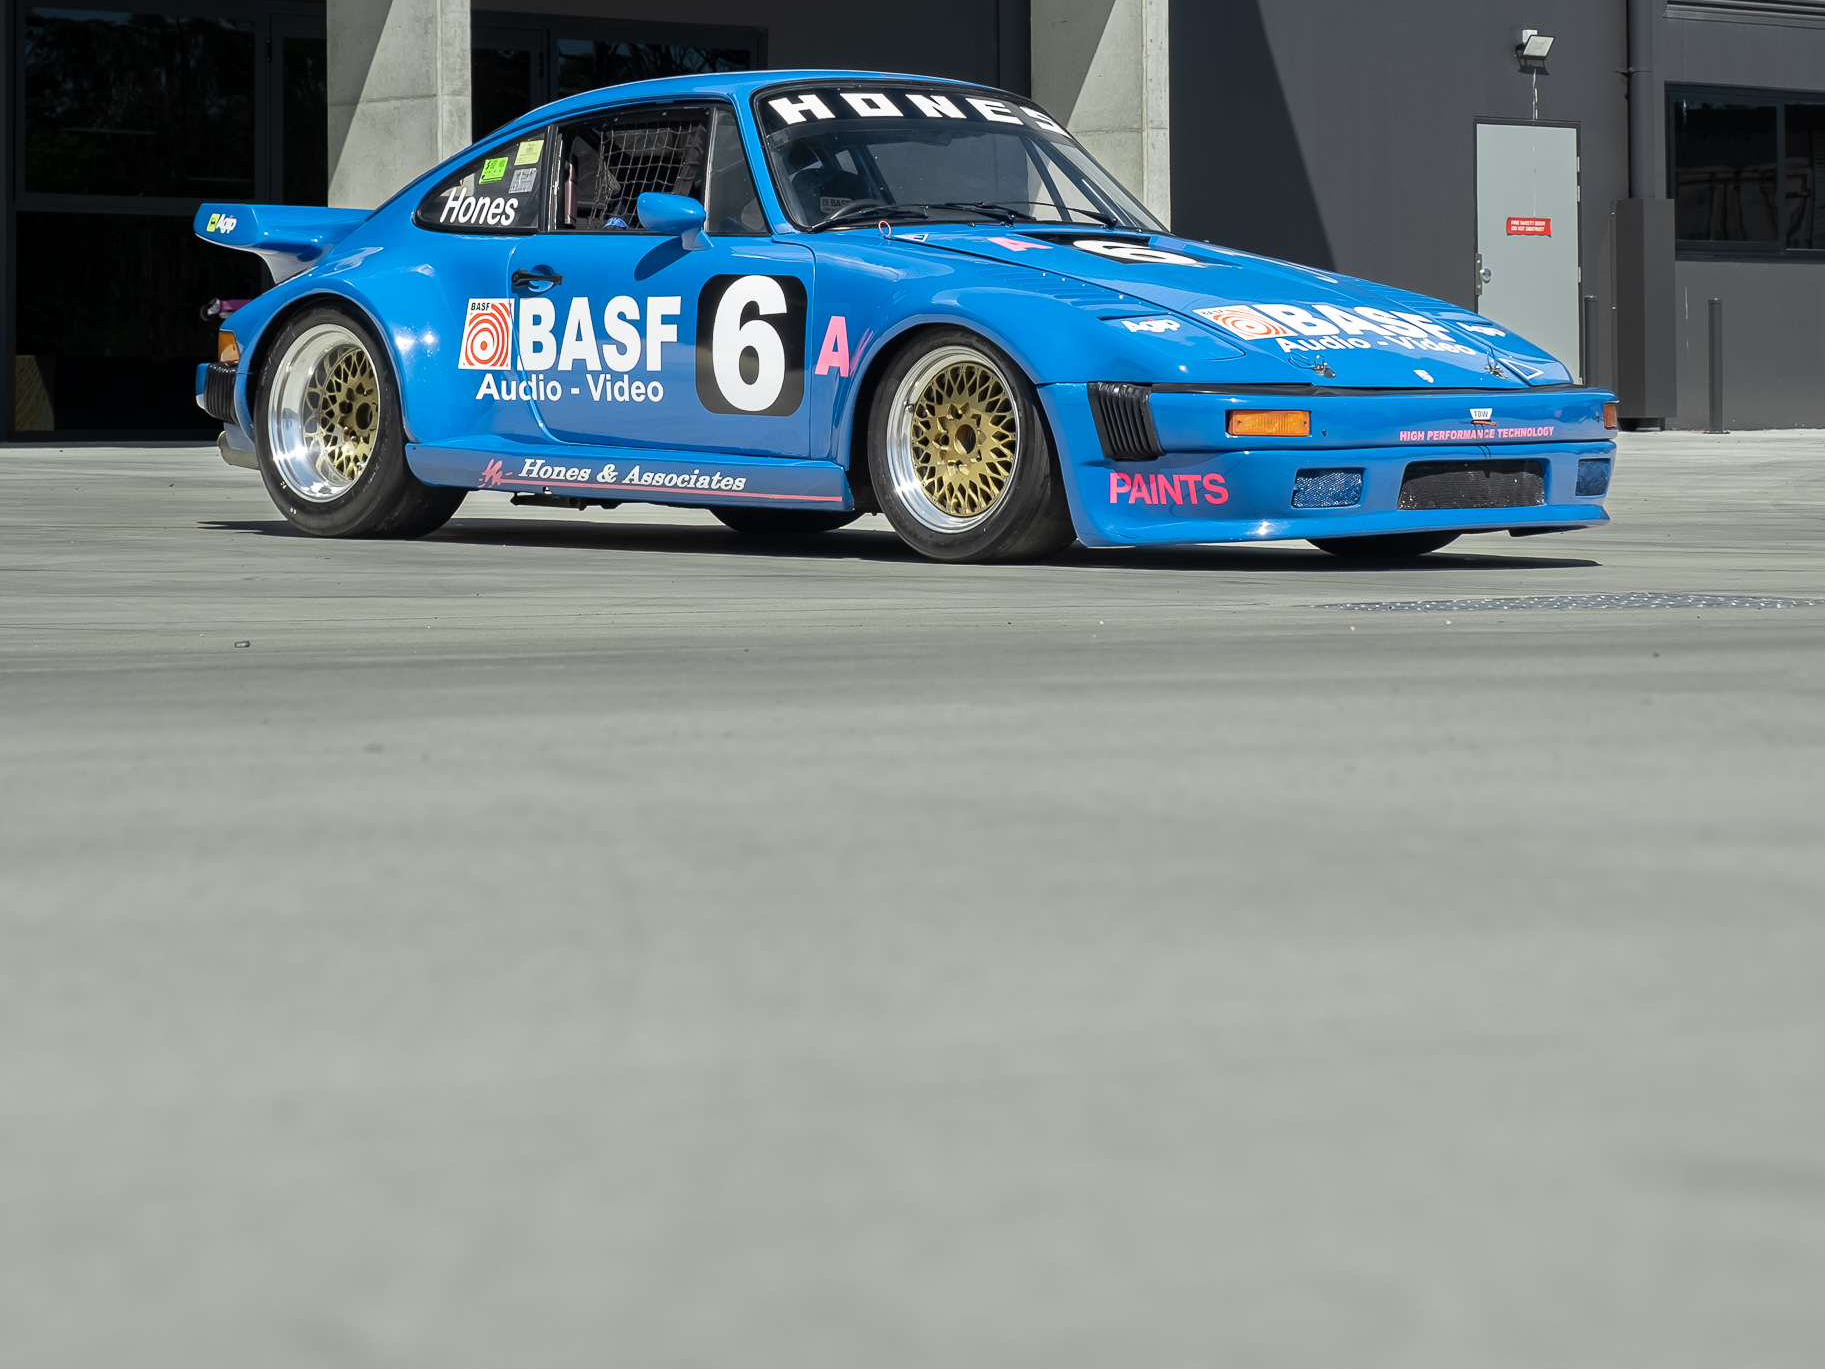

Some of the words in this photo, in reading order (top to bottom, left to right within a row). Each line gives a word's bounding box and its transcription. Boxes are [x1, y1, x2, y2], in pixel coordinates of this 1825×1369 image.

[768, 93, 1074, 139] HONES
[439, 186, 520, 226] Hones
[470, 302, 492, 312] BASF
[1251, 303, 1457, 343] BASF
[517, 295, 682, 372] BASF
[1121, 317, 1181, 333] Agip
[712, 275, 788, 412] 6
[1274, 337, 1370, 353] Audio
[1388, 336, 1477, 356] Video
[475, 373, 562, 401] Audio
[570, 387, 580, 395] -
[585, 373, 664, 402] Video
[1473, 410, 1489, 418] TOW
[1400, 431, 1425, 441] HIGH
[1427, 429, 1495, 441] PERFORMANCE
[1498, 427, 1555, 438] TECHNOLOGY
[518, 458, 592, 482] Hones
[596, 464, 617, 483] &
[622, 465, 747, 491] Associates
[1109, 472, 1229, 505] PAINTS
